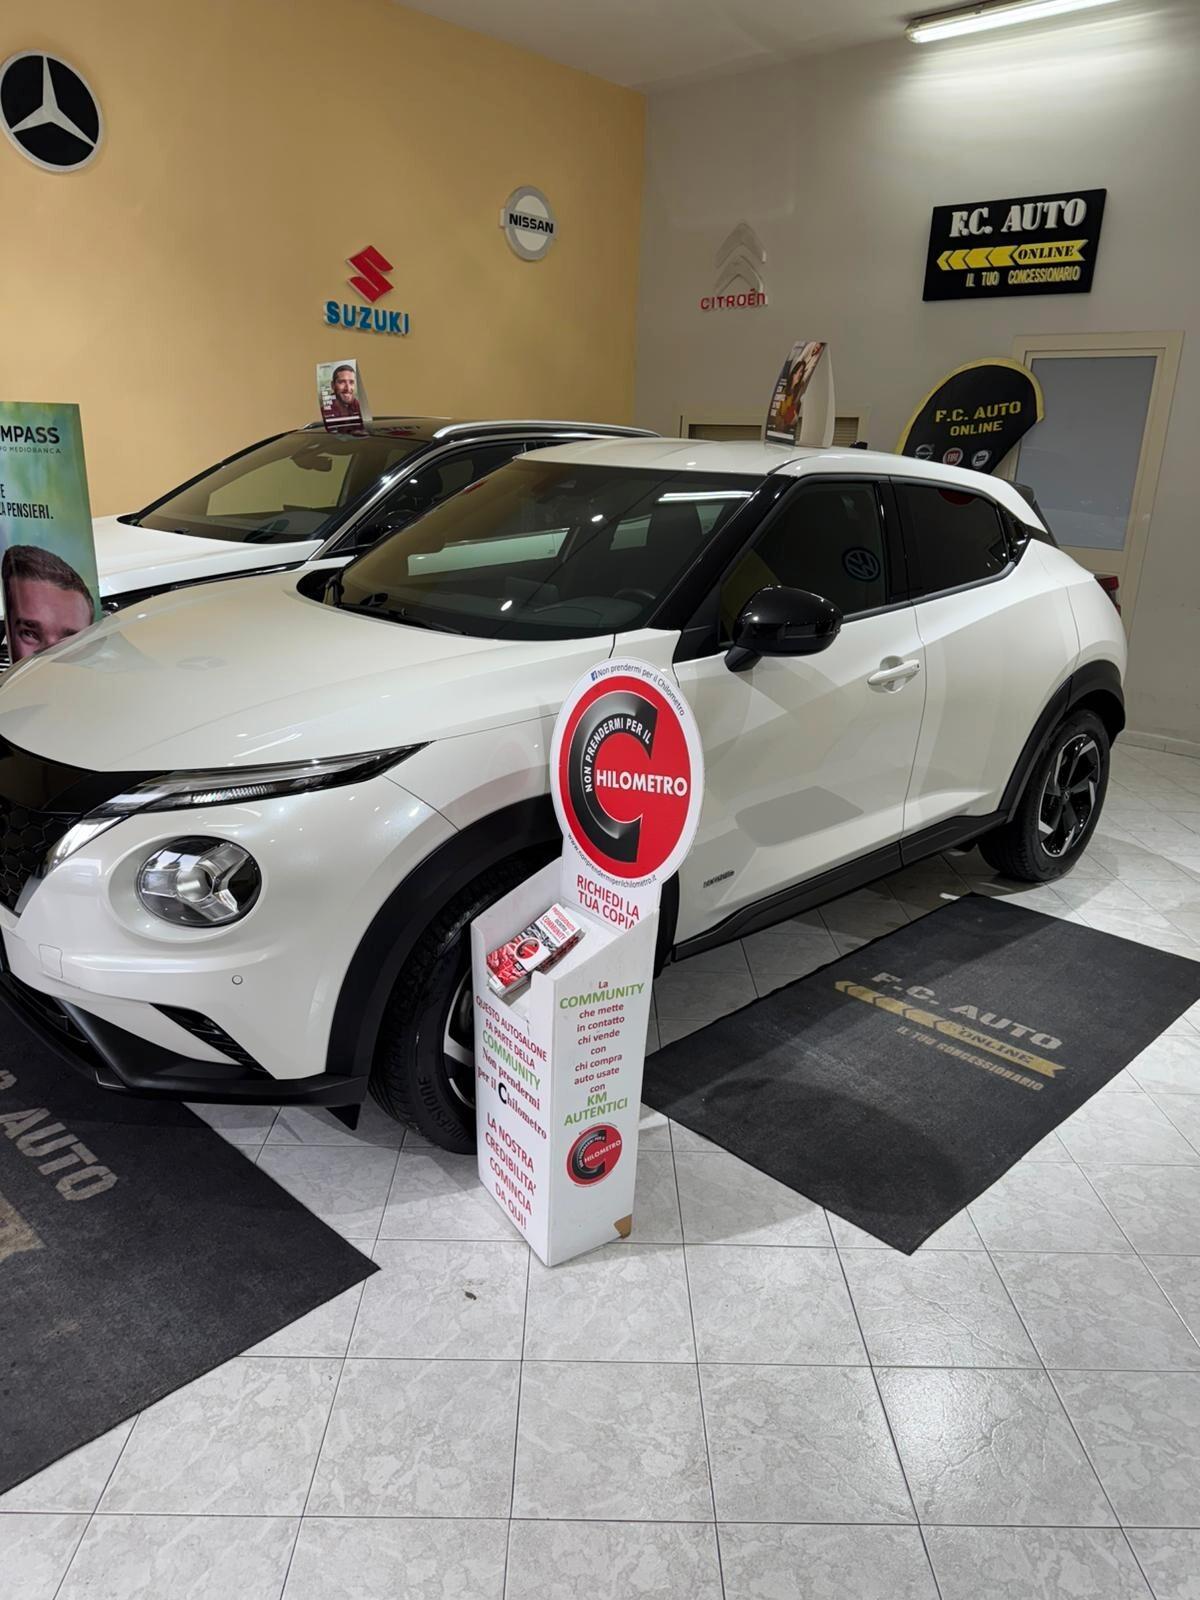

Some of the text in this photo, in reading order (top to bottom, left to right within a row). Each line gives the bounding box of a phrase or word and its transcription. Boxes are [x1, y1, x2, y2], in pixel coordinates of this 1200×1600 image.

[509, 213, 554, 234] NISSAN
[949, 198, 1087, 237] F.C. AUTO
[1018, 245, 1075, 260] ONLINE
[965, 266, 1081, 287] IL TUO CONCESSIONARIO
[325, 301, 410, 335] SUZUKI
[950, 420, 1004, 437] ONLINE
[973, 401, 1022, 420] AUTO
[7, 502, 54, 520] PENSIERI.
[597, 663, 685, 716] Non prendermi per il Chilometro
[584, 717, 652, 793] NON PRENDERMI PER IL
[576, 874, 640, 920] RICHIEDI LA
[578, 890, 635, 930] TUA COPIA
[560, 983, 645, 1009] COMMUNITY
[598, 981, 609, 989] La
[475, 995, 547, 1062] QUESTO AUTOSALONE
[576, 1016, 625, 1032] in contatto
[579, 1003, 624, 1019] che mette
[949, 1004, 1063, 1050] AUTO
[485, 1019, 535, 1069] FA PARTE DELLA
[577, 1029, 620, 1045] chi vende
[590, 1046, 607, 1055] con
[958, 1026, 1035, 1064] ONLINE
[482, 1030, 541, 1090] COMMUNITY
[482, 1046, 540, 1110] Non prendermi
[574, 1067, 620, 1085] auto usate
[575, 1054, 623, 1072] chi compra
[911, 1031, 935, 1045] TUO
[936, 1041, 1044, 1091] CONCESSIONARIO
[477, 1066, 547, 1139] per il Chilometro
[587, 1091, 608, 1106] KM
[590, 1084, 606, 1093] con
[564, 1097, 628, 1126] AUTENTICI
[0, 1107, 119, 1201] AUTO
[487, 1112, 534, 1173] LA NOSTRA
[485, 1132, 537, 1196] CREDIBILITA'
[489, 1157, 532, 1215] COMINCIA
[495, 1182, 527, 1229] DA QUI!
